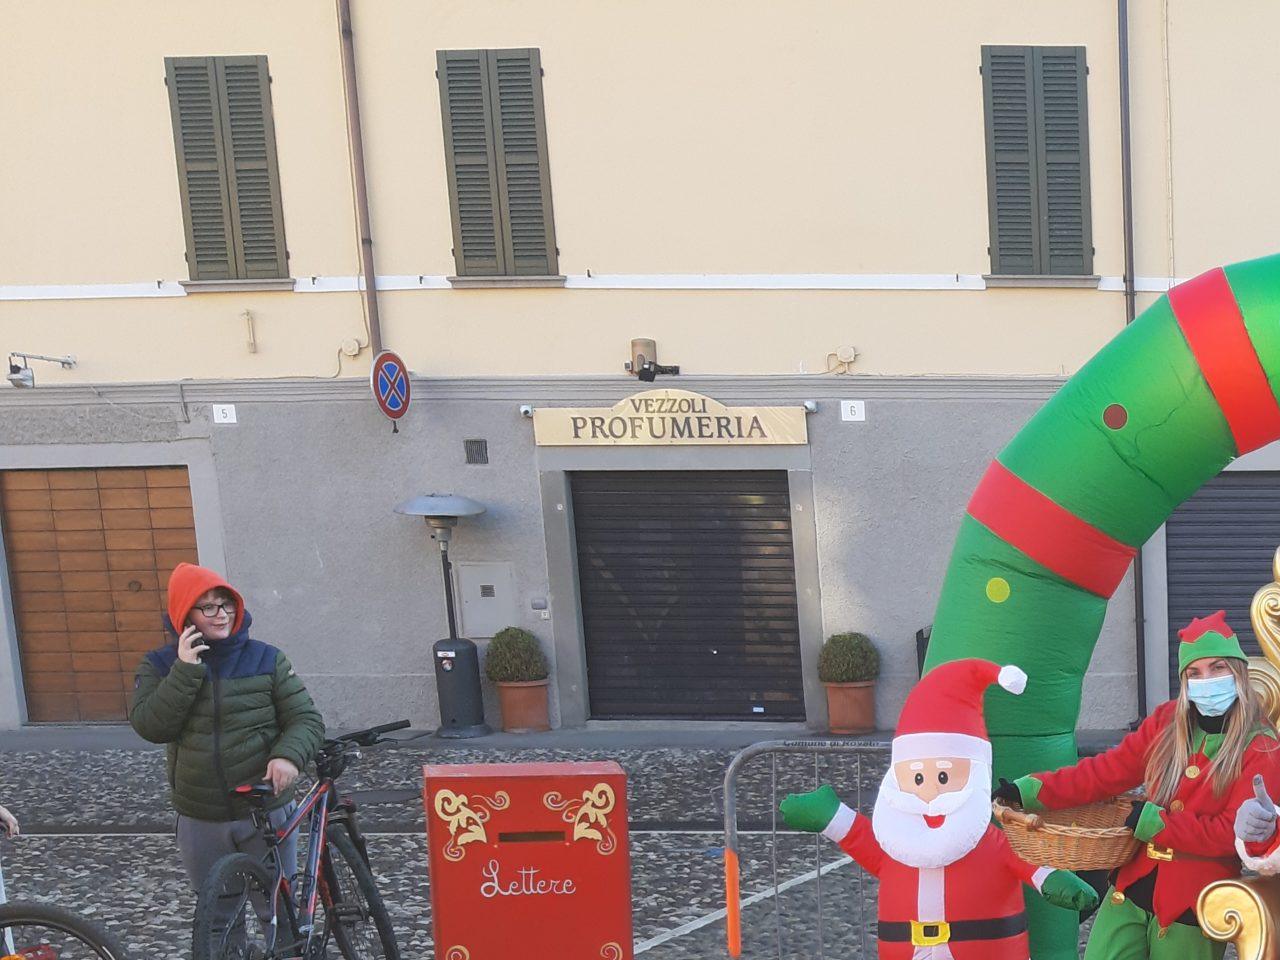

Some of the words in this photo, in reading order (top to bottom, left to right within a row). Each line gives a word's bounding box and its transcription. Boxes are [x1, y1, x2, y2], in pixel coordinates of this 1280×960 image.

[221, 408, 229, 419] 5
[630, 398, 707, 414] VEZZOLI
[850, 405, 857, 416] 6
[571, 415, 768, 440] PROFUMERIA
[480, 859, 576, 898] Lettere
